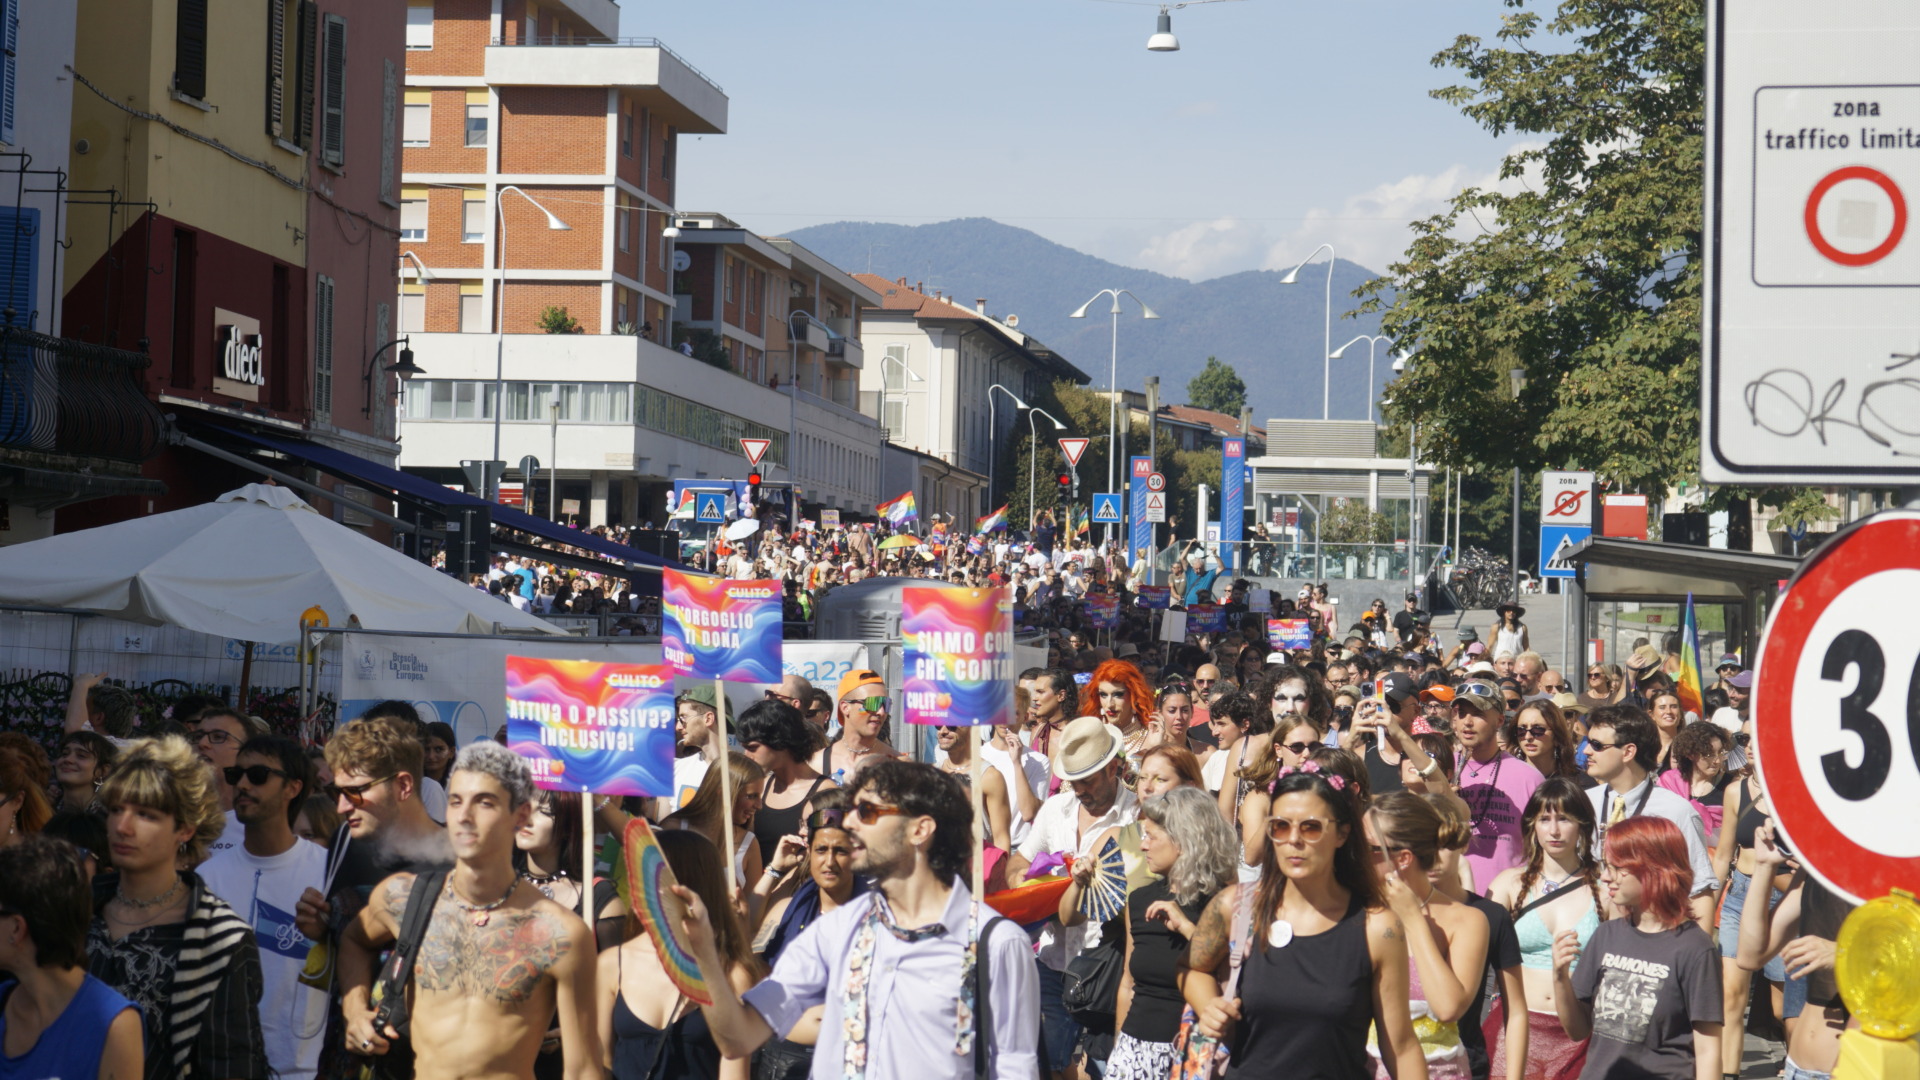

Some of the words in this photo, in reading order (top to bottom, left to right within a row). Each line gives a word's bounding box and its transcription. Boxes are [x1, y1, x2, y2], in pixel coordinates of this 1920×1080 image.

[1833, 101, 1880, 117] zona
[1765, 128, 1849, 149] traffico
[1228, 443, 1240, 453] M
[1136, 461, 1150, 471] M
[1150, 477, 1161, 486] 30
[728, 587, 772, 598] CULITO
[675, 604, 754, 629] L'ORGOGLIO
[685, 629, 696, 645] TI
[702, 630, 740, 649] DONA
[916, 631, 975, 654] SIAMO
[916, 658, 946, 681] CHE
[608, 674, 661, 688] CULITO
[568, 705, 579, 724] O
[1820, 629, 1920, 802] 3
[1601, 952, 1670, 979] RAMONES
